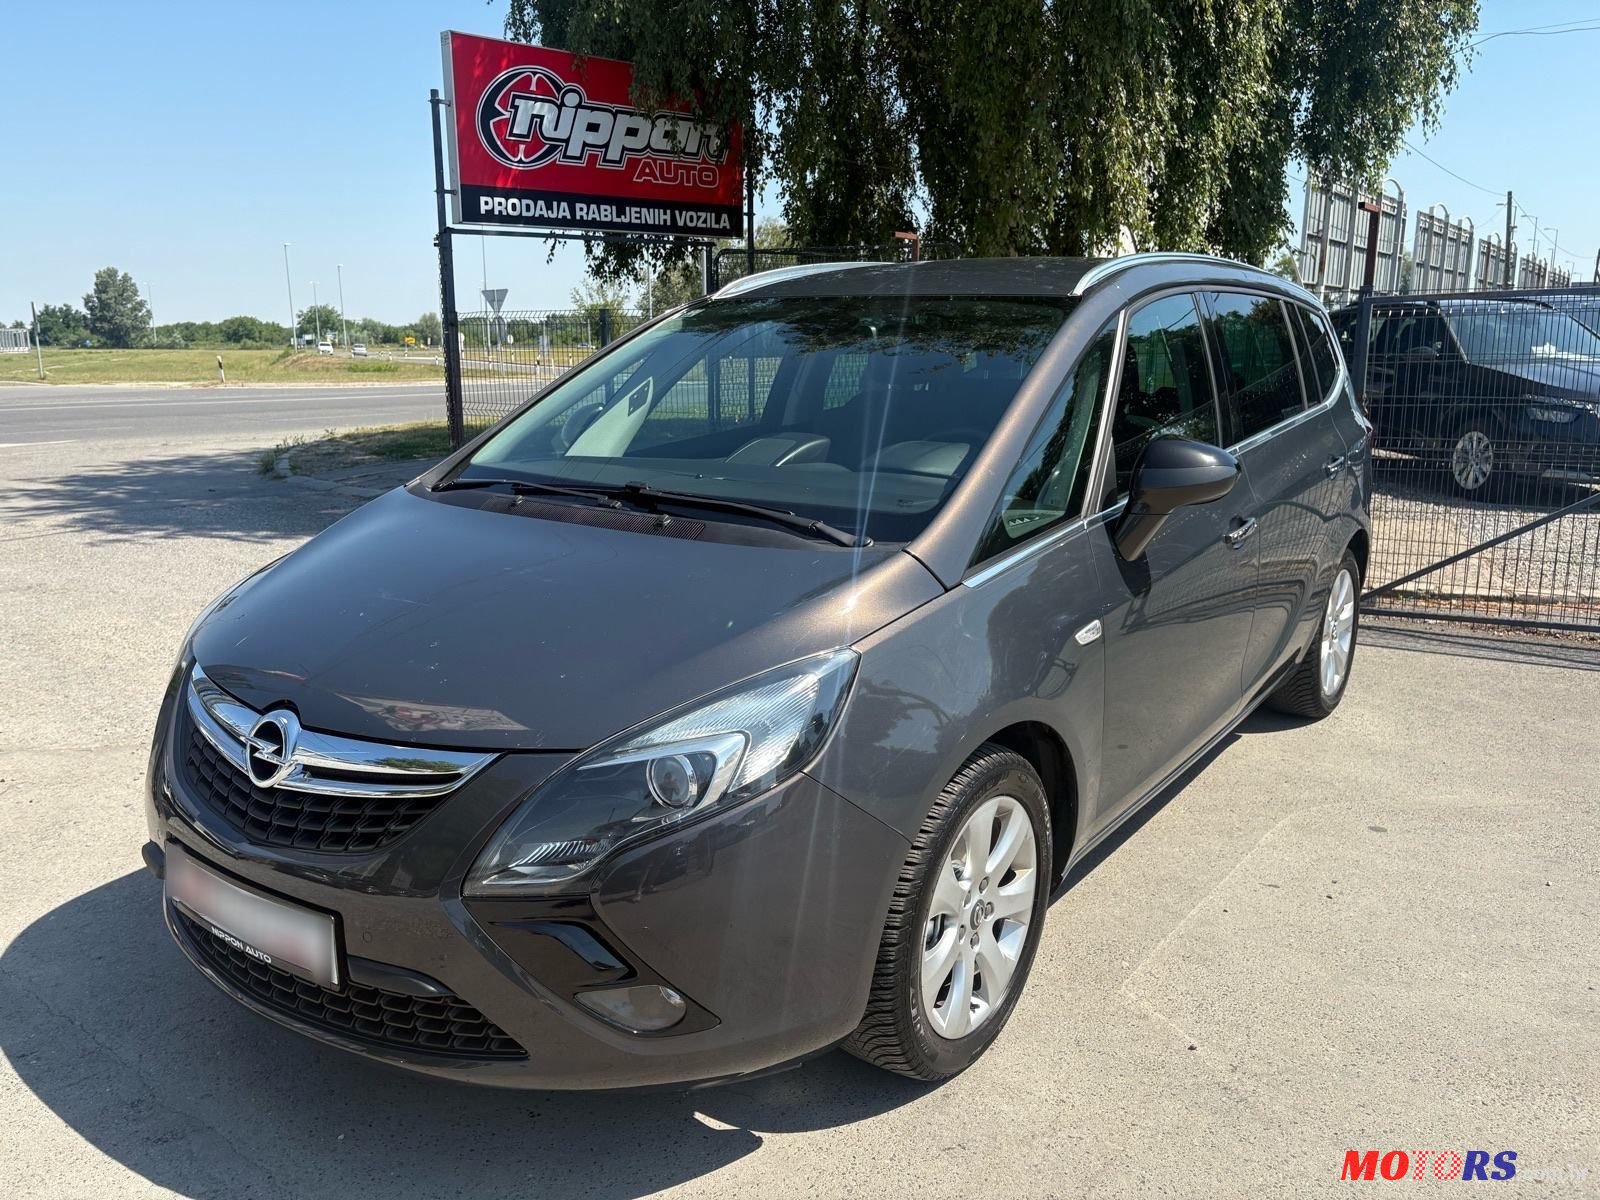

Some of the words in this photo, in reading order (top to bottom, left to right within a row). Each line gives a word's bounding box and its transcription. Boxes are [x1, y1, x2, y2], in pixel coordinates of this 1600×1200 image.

[633, 160, 719, 189] AUTO
[479, 195, 571, 220] PRODAJA
[575, 203, 672, 227] RABLJENIH
[675, 206, 731, 230] VOZILA
[211, 926, 244, 950] NIPPON
[245, 946, 273, 964] AUTO
